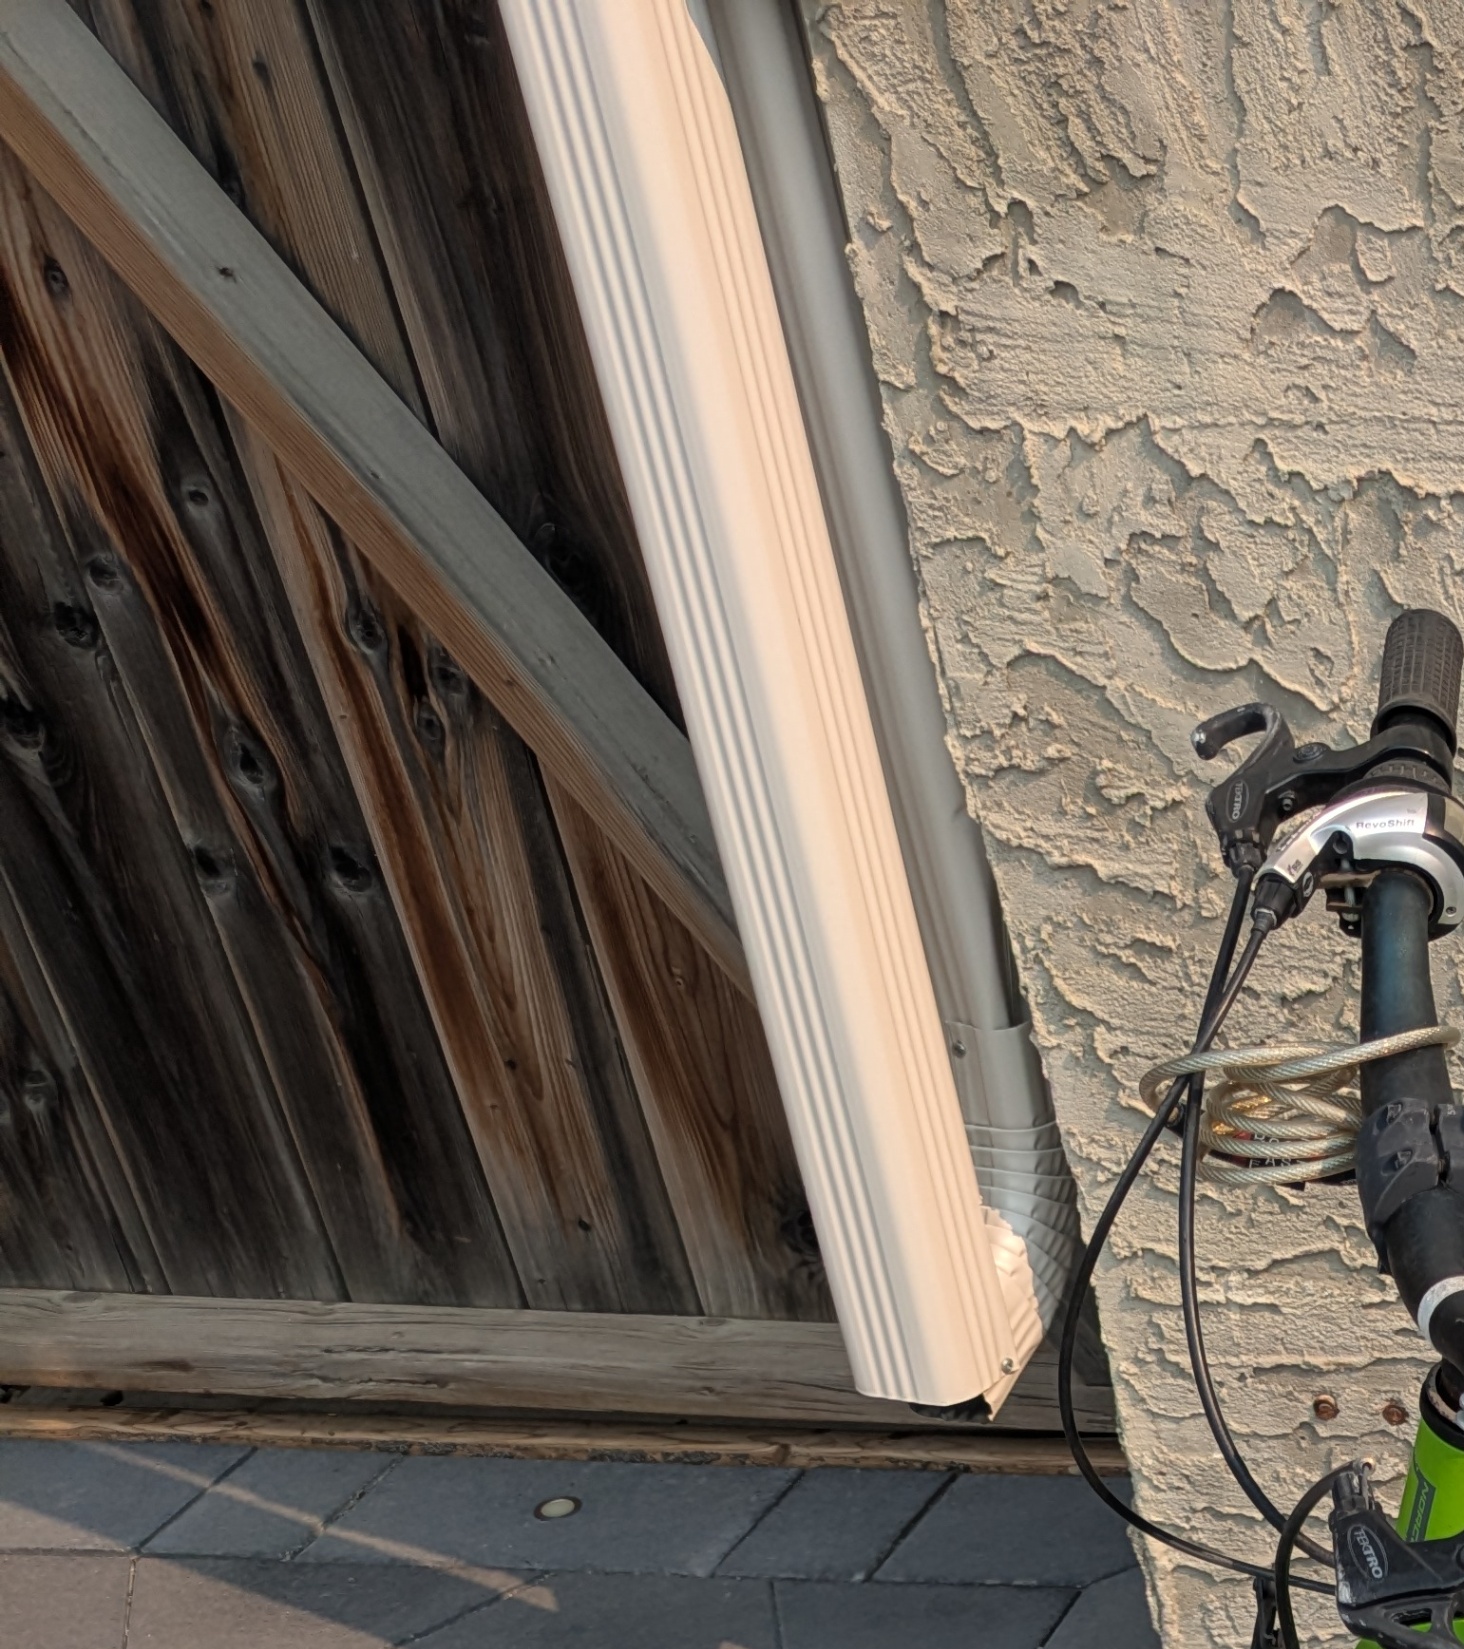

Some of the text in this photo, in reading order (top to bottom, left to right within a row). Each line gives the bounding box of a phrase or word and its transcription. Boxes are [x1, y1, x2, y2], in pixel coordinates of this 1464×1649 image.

[1356, 819, 1415, 829] RevoShift
[1410, 1481, 1429, 1542] NORC
[1353, 1528, 1383, 1579] TEKTRO
